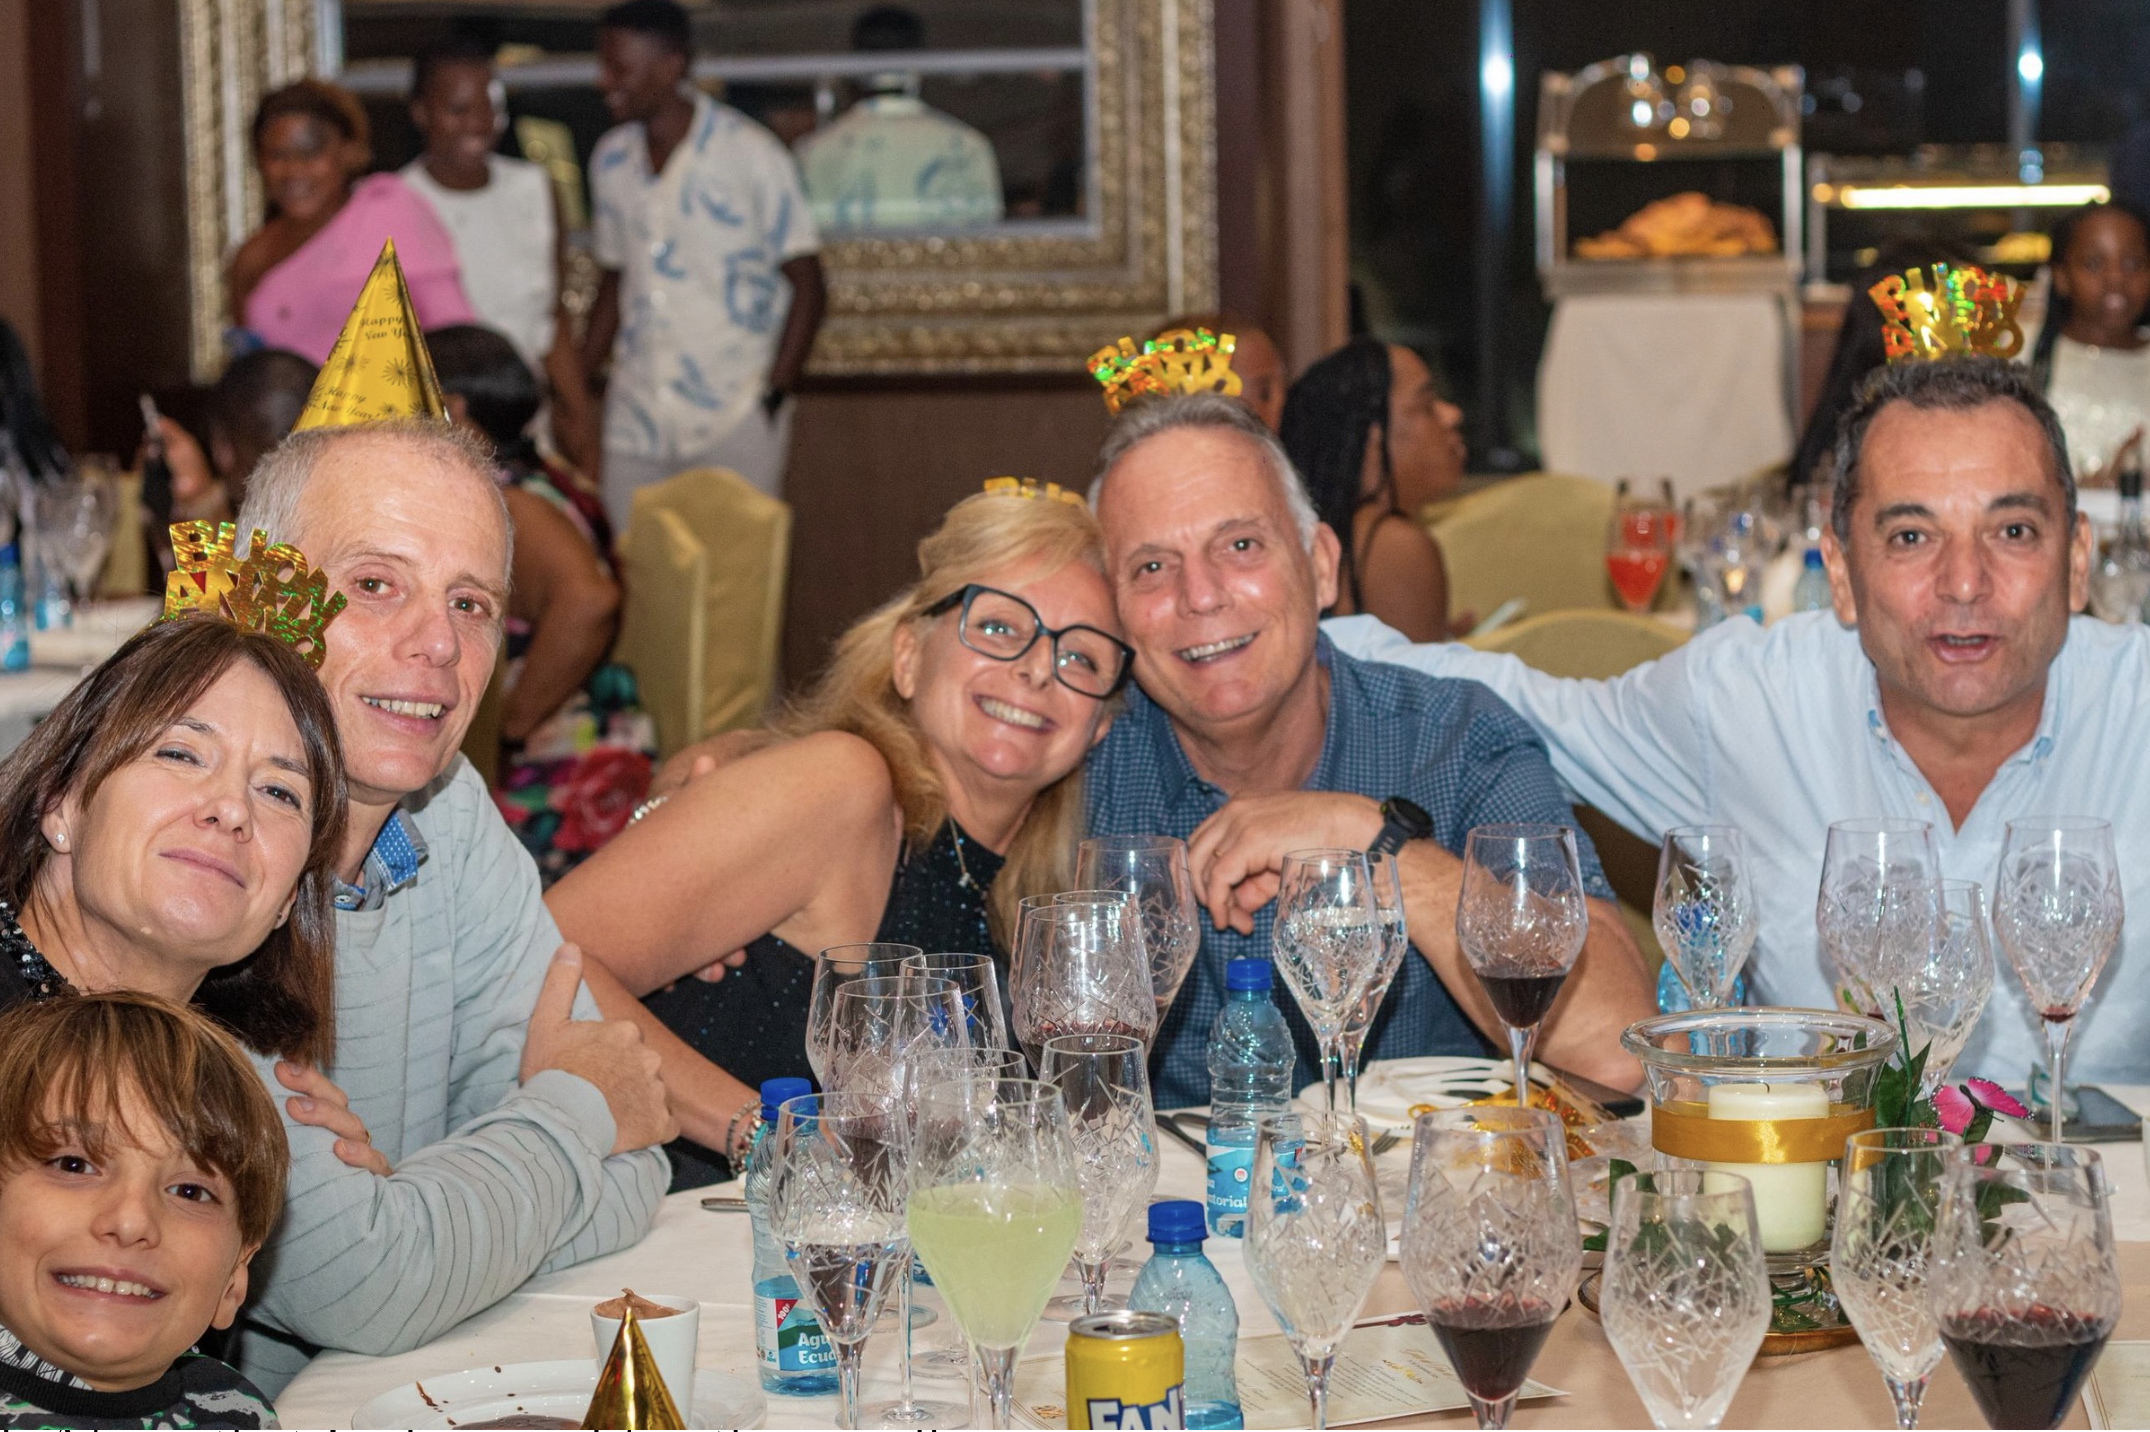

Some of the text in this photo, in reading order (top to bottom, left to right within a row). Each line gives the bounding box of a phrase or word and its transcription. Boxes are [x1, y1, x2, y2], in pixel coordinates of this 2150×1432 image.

[360, 316, 403, 328] Happy
[798, 1333, 829, 1349] Agu
[1087, 1385, 1184, 1430] FAN
